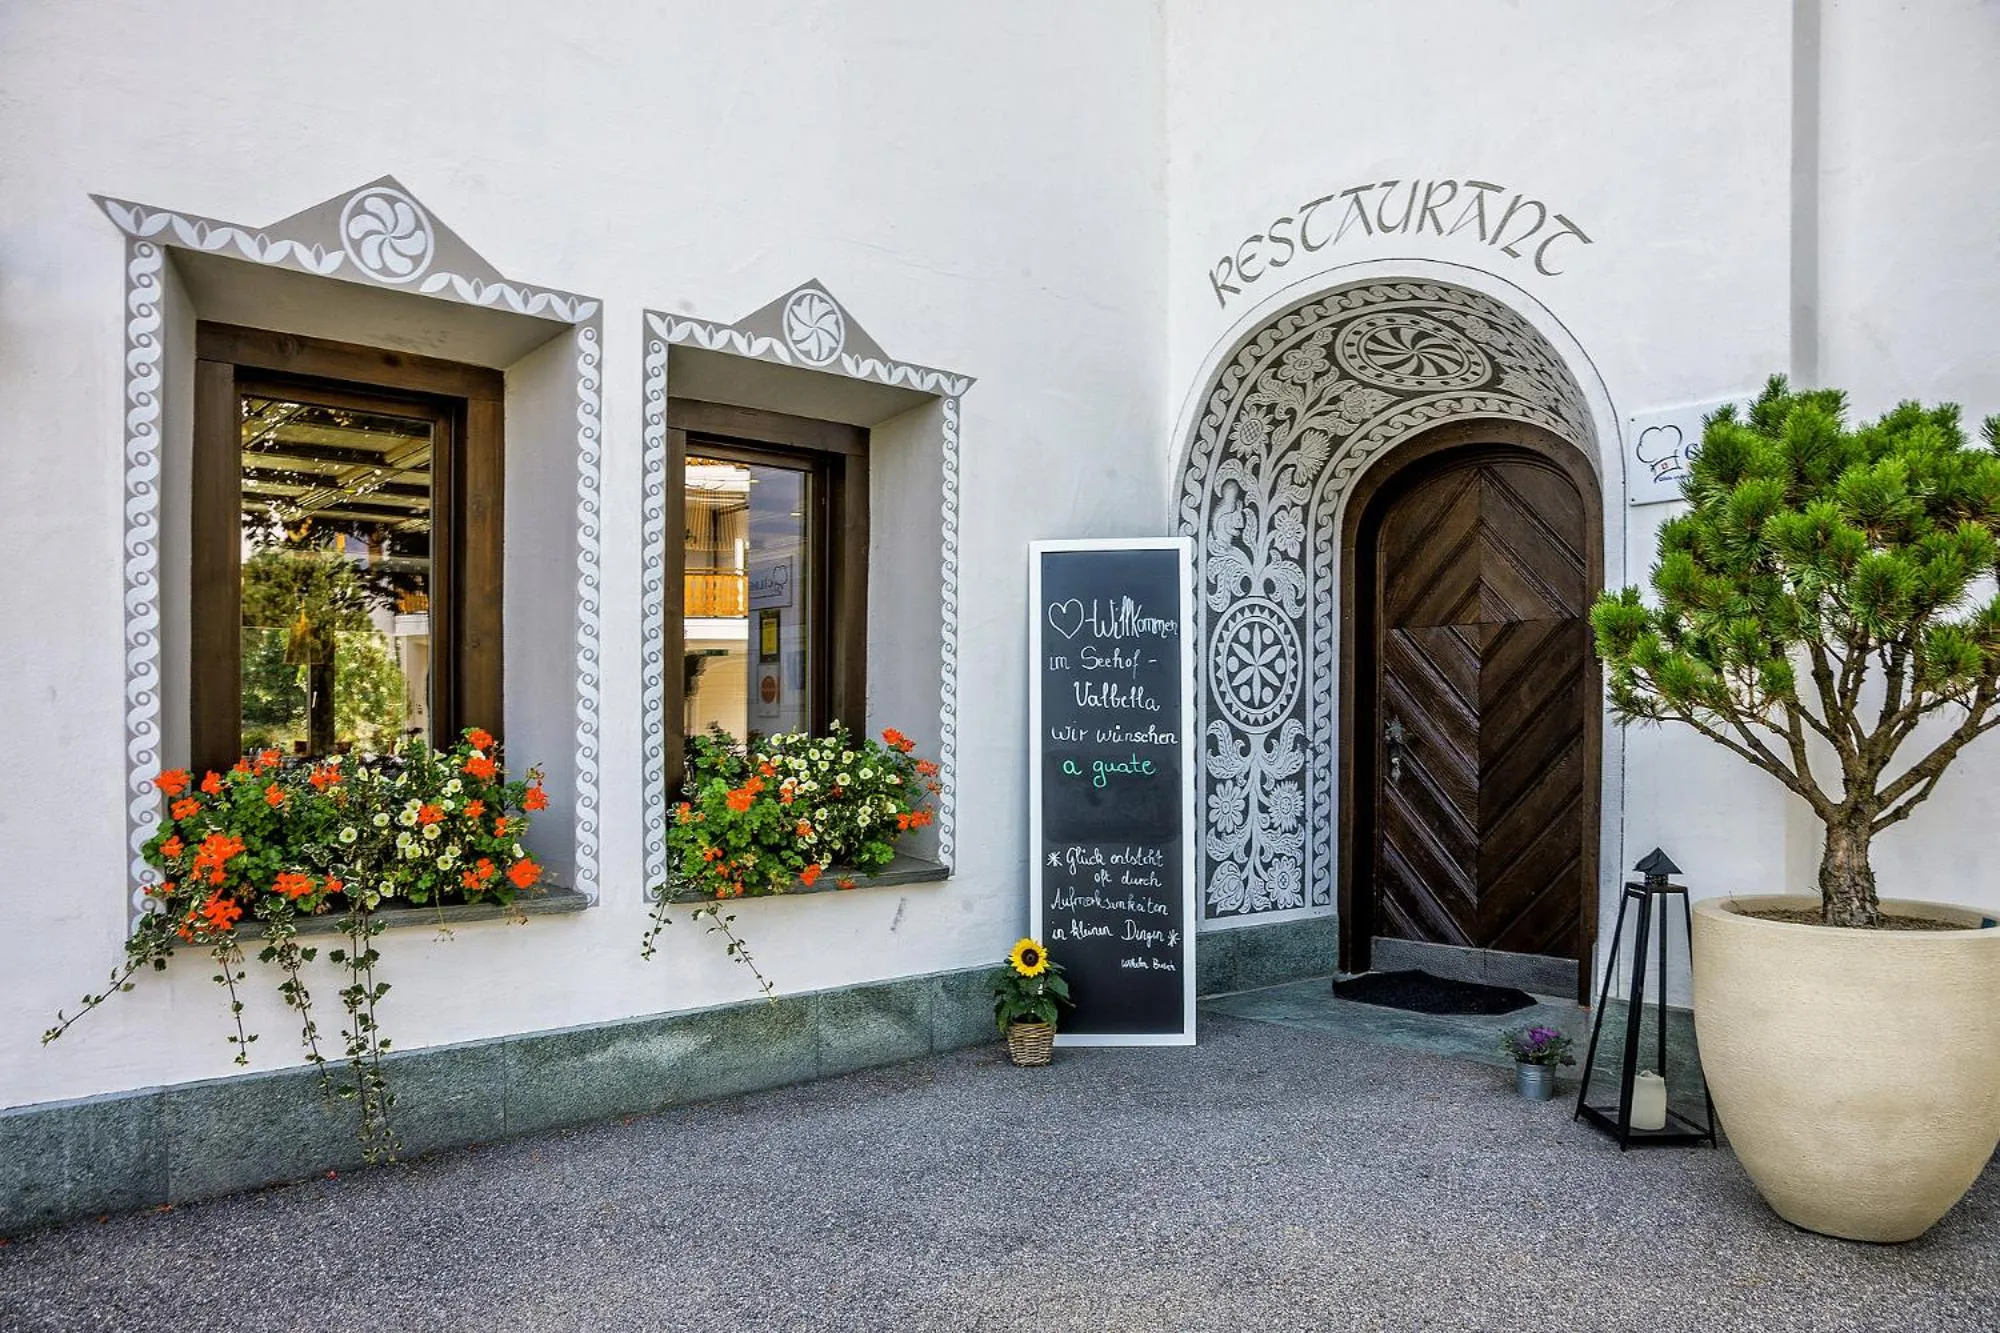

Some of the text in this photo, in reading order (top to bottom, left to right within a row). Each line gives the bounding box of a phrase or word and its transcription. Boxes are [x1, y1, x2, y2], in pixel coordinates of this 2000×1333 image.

[1208, 179, 1594, 310] RESTAURANT
[1049, 655, 1070, 671] im
[1080, 645, 1141, 680] Seehof
[1073, 681, 1160, 712] Valbella
[1096, 724, 1179, 745] wünschen
[1063, 752, 1157, 788] a guate
[1120, 869, 1163, 888] durch
